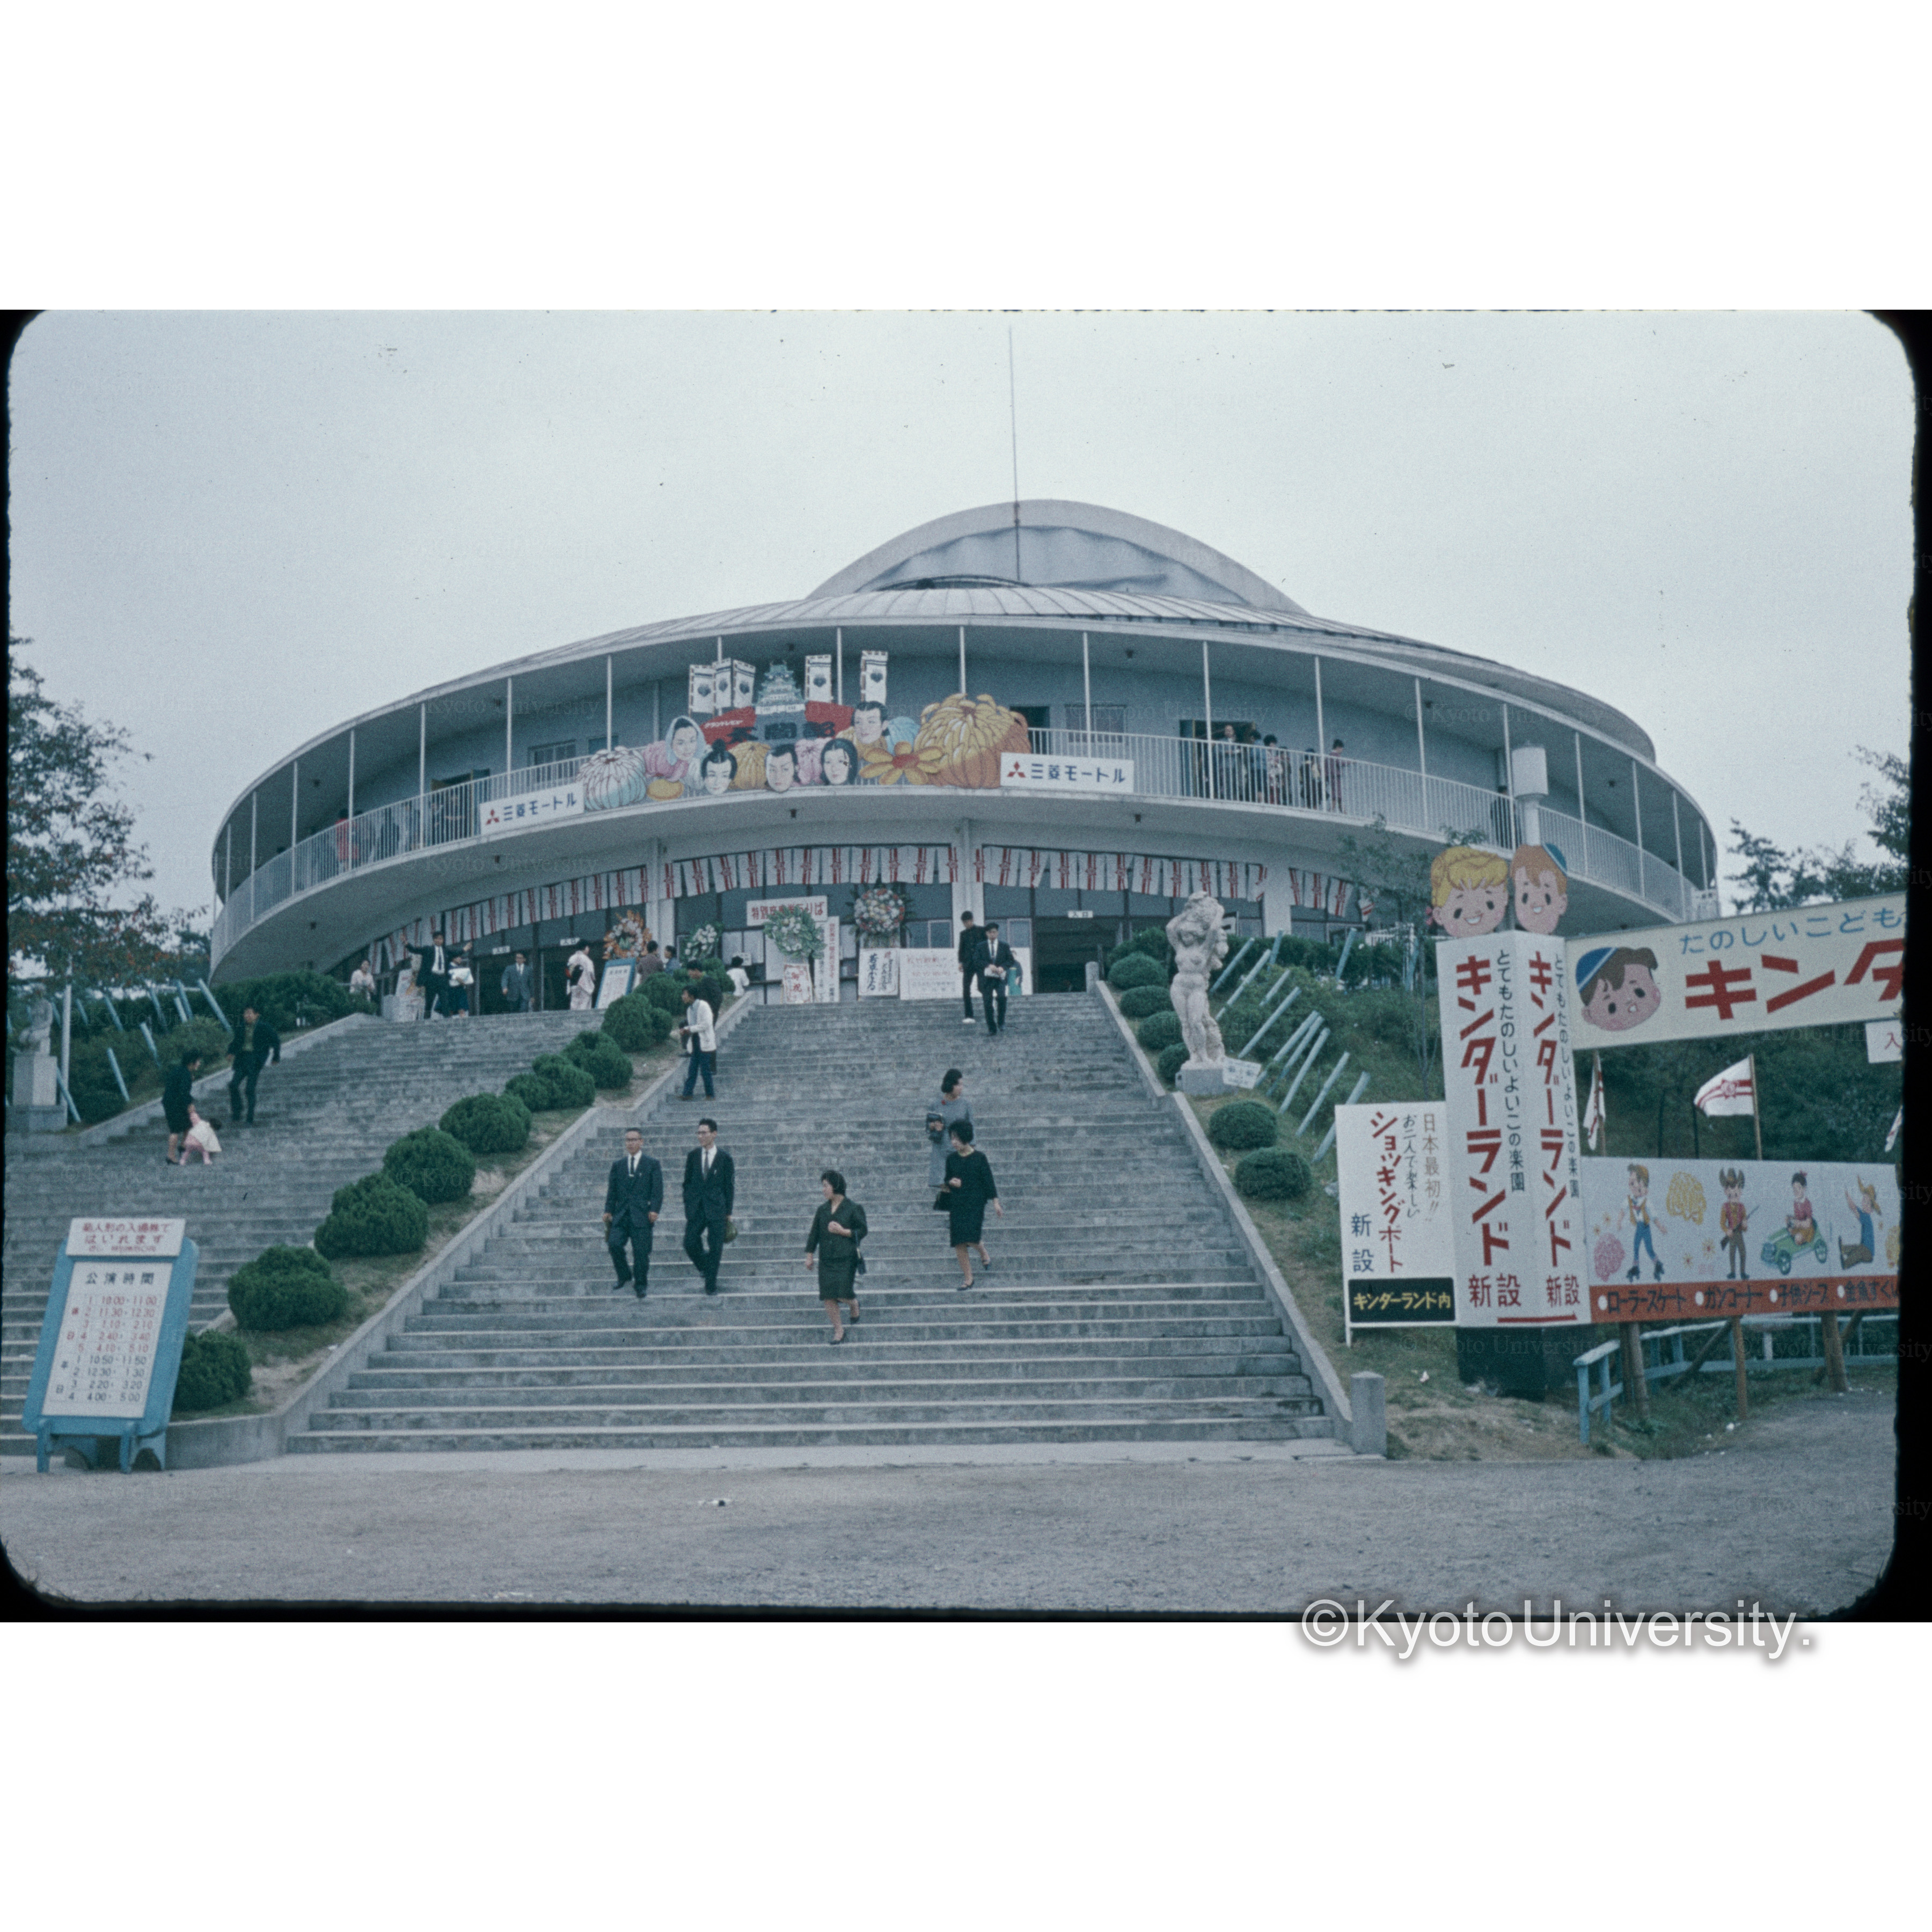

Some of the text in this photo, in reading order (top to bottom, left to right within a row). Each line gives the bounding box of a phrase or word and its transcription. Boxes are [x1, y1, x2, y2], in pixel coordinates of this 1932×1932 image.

[1031, 763, 1126, 784] 三菱モートル
[504, 793, 577, 822] 三菱モートル
[1680, 908, 1906, 954] たのしいこども
[1497, 949, 1525, 1192] とてもたのしいよいこの楽園
[1457, 955, 1509, 1266] キンダーランド
[1529, 950, 1571, 1267] キンダーランド
[1351, 1212, 1374, 1272] 新設
[1353, 1291, 1451, 1311] キンダーランド内
[1468, 1273, 1521, 1307] 新設
[1546, 1274, 1580, 1308] 新設
